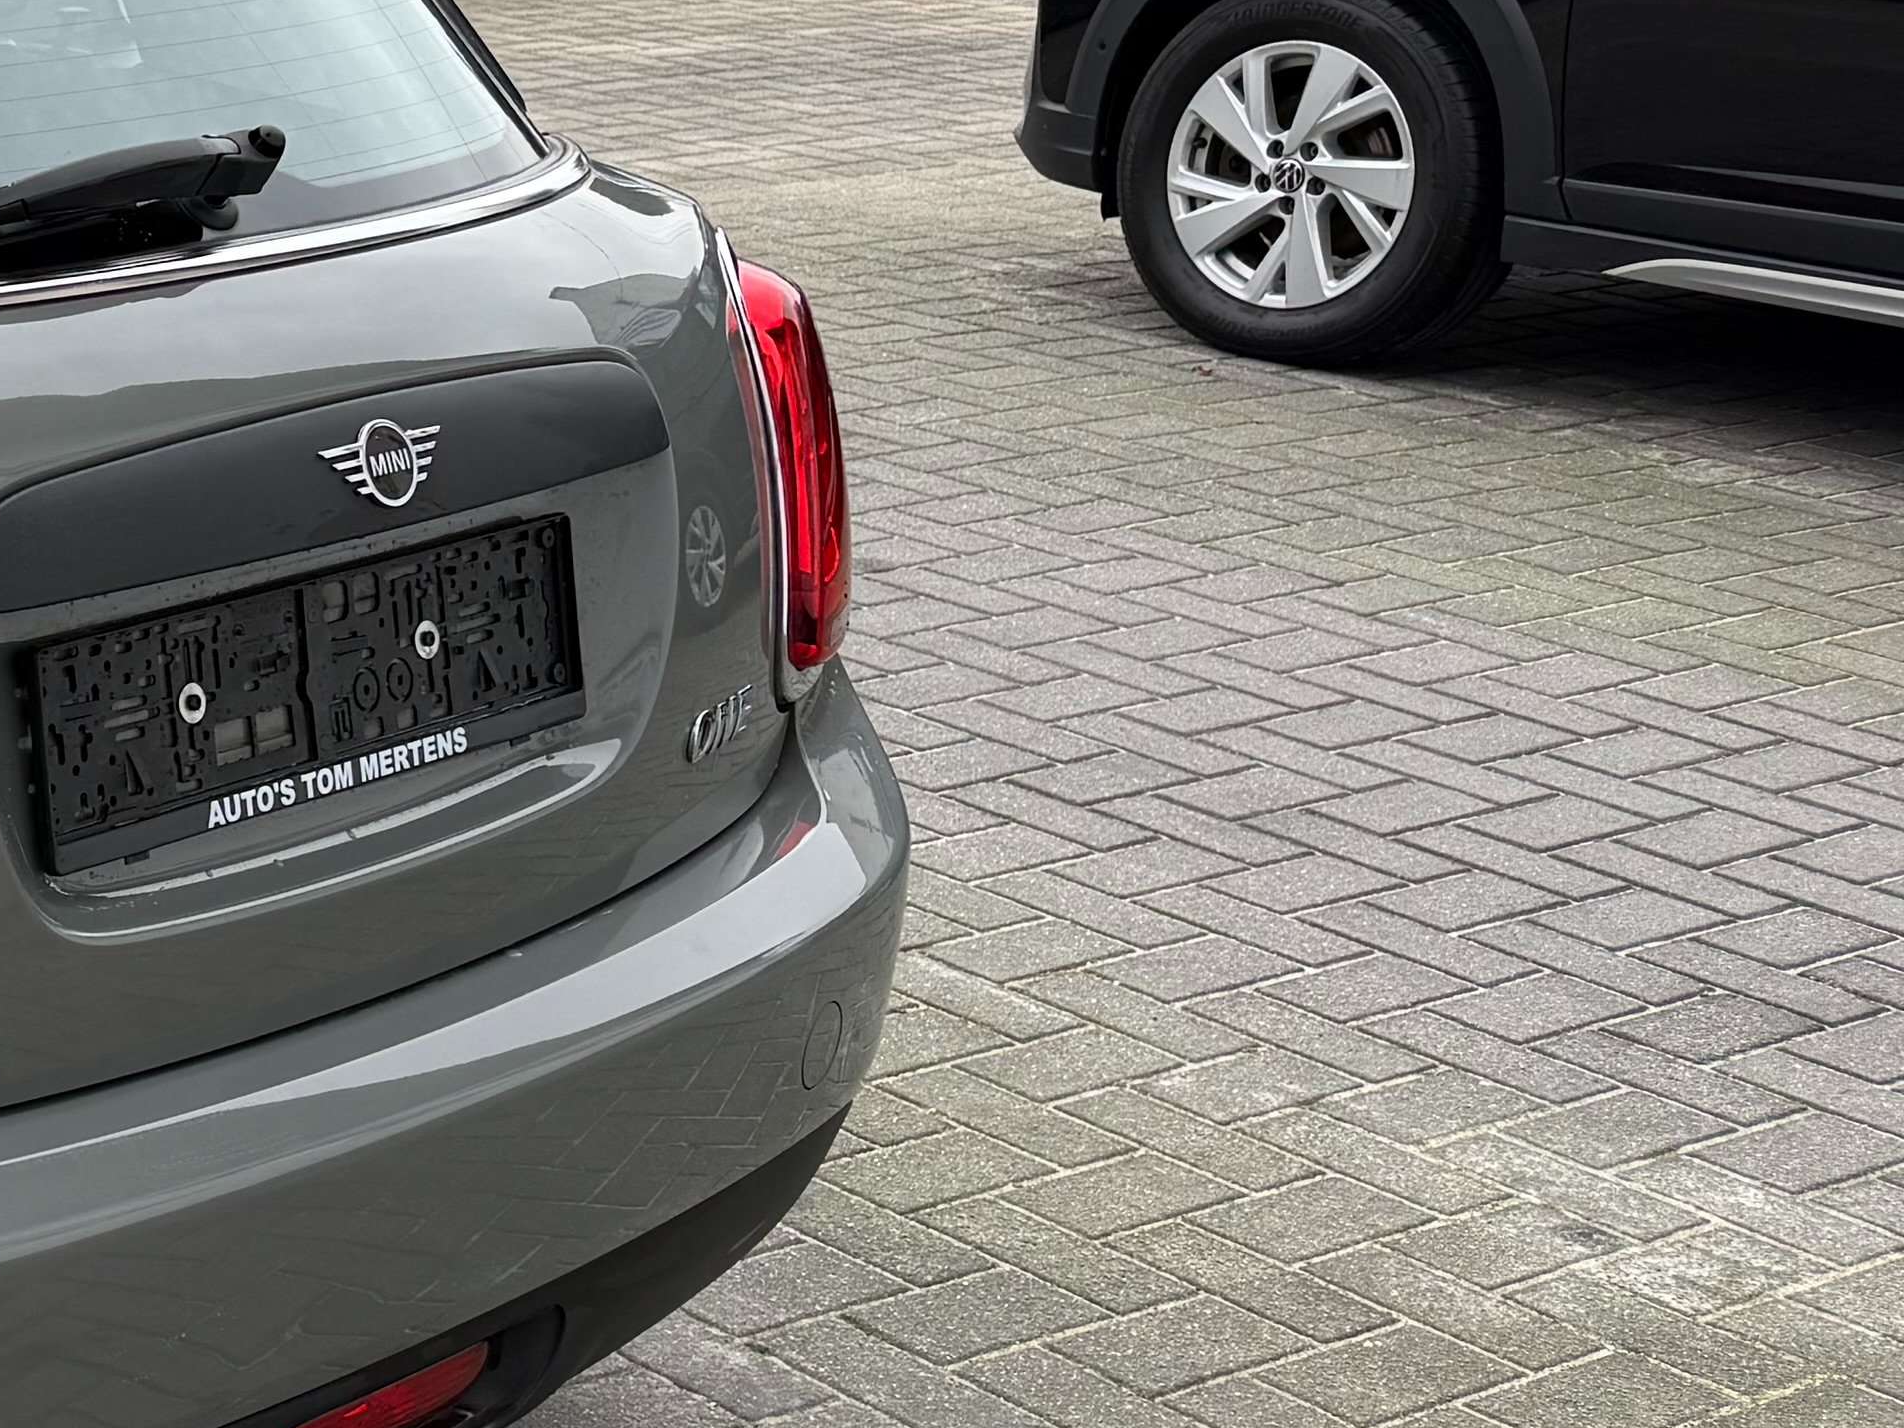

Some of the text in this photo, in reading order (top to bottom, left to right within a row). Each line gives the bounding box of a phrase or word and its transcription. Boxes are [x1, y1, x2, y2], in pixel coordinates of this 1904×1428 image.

[369, 448, 411, 477] MINI
[207, 726, 468, 829] AUTO'S TOM MERTENS
